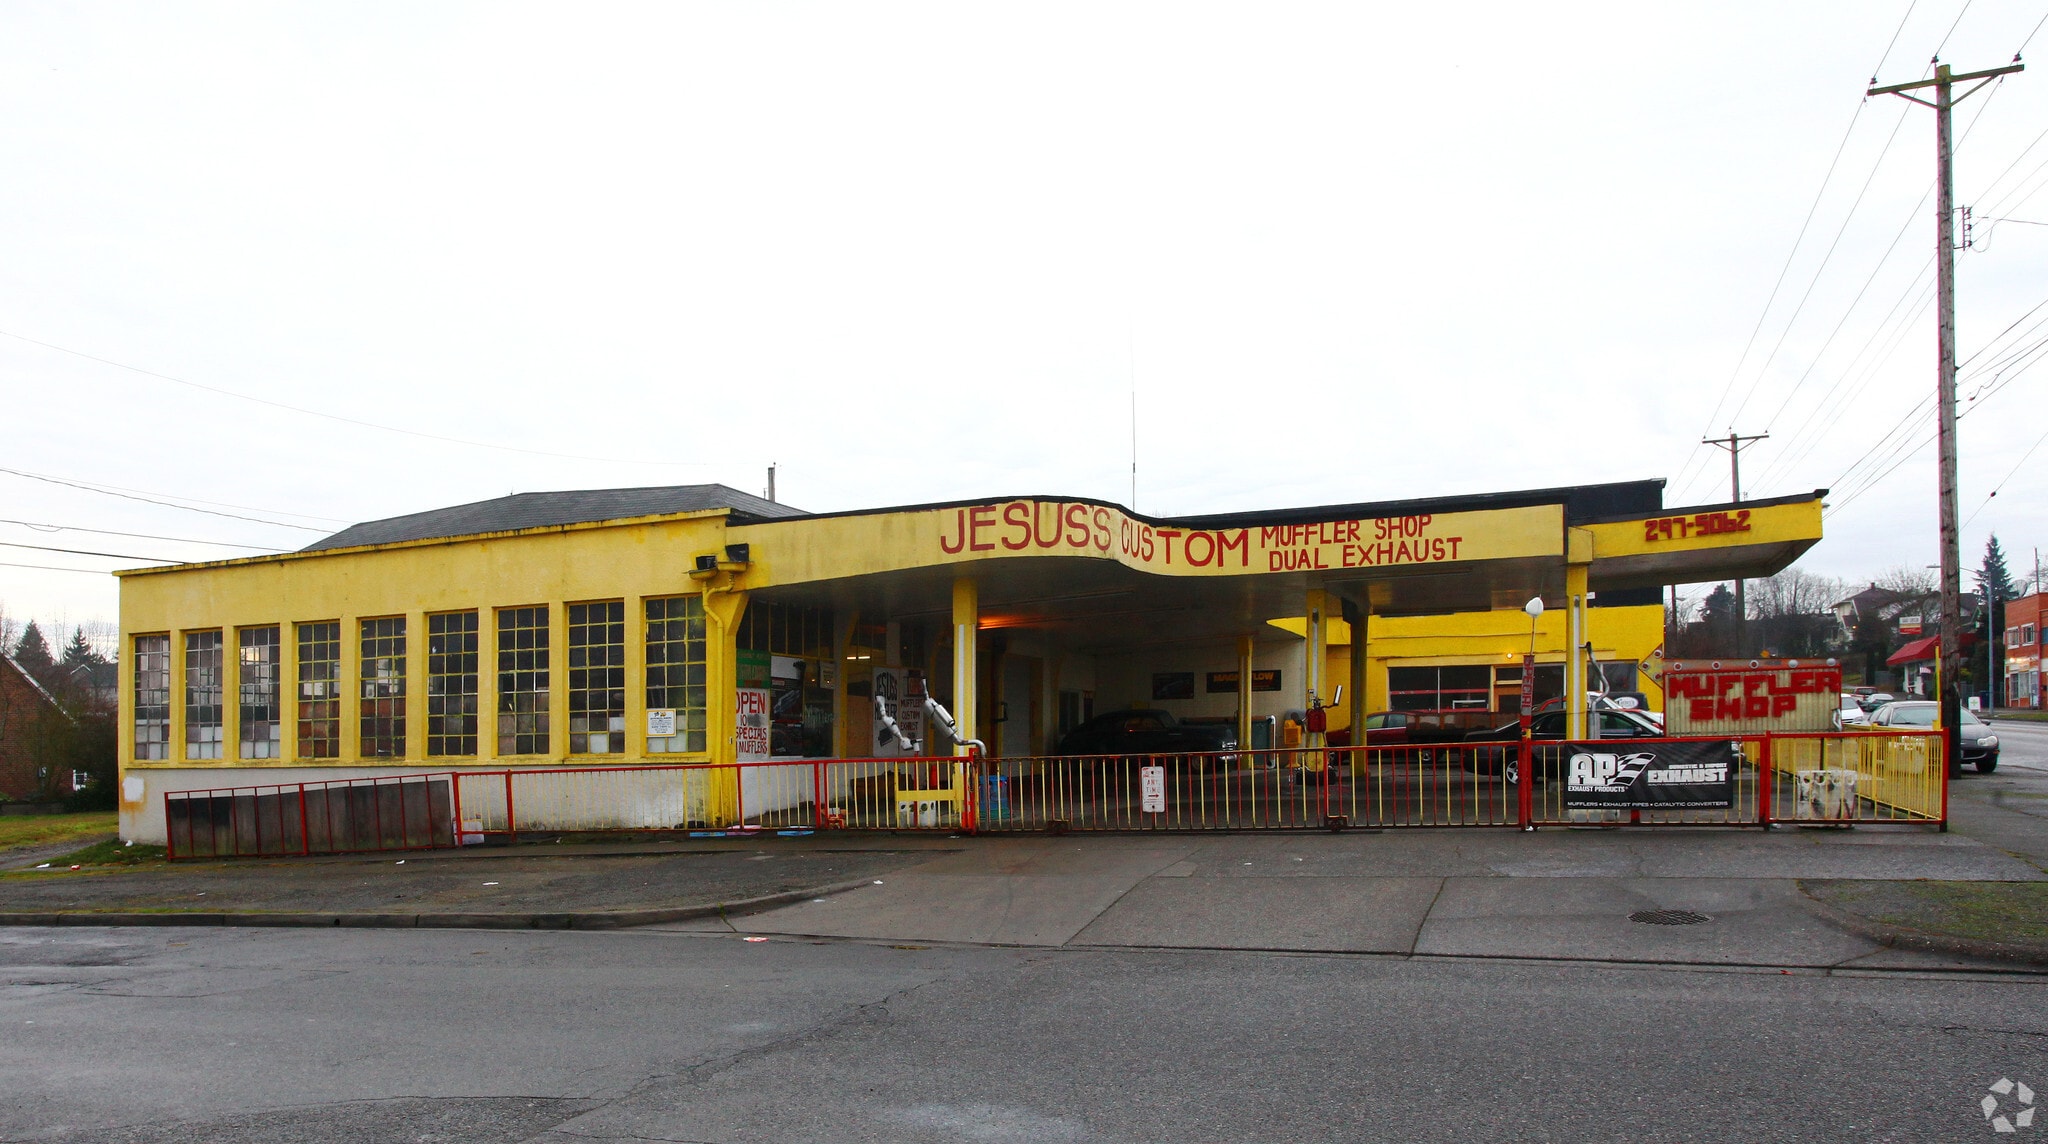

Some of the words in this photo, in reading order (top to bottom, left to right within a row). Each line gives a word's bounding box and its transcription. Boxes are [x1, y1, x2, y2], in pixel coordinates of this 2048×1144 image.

[940, 502, 1111, 554] JESUS'S
[1121, 519, 1249, 568] CUSTOM
[1260, 519, 1361, 548] MUFFLER
[1374, 514, 1432, 540] SHOP
[1644, 510, 1751, 541] 297-5062
[1269, 548, 1329, 571] DUAL
[1342, 537, 1463, 567] EXHAUST
[1668, 671, 1839, 699] MUFFLER
[1690, 695, 1796, 721] SHOP
[1567, 753, 1619, 787] AP
[1647, 769, 1728, 783] EXHAUST
